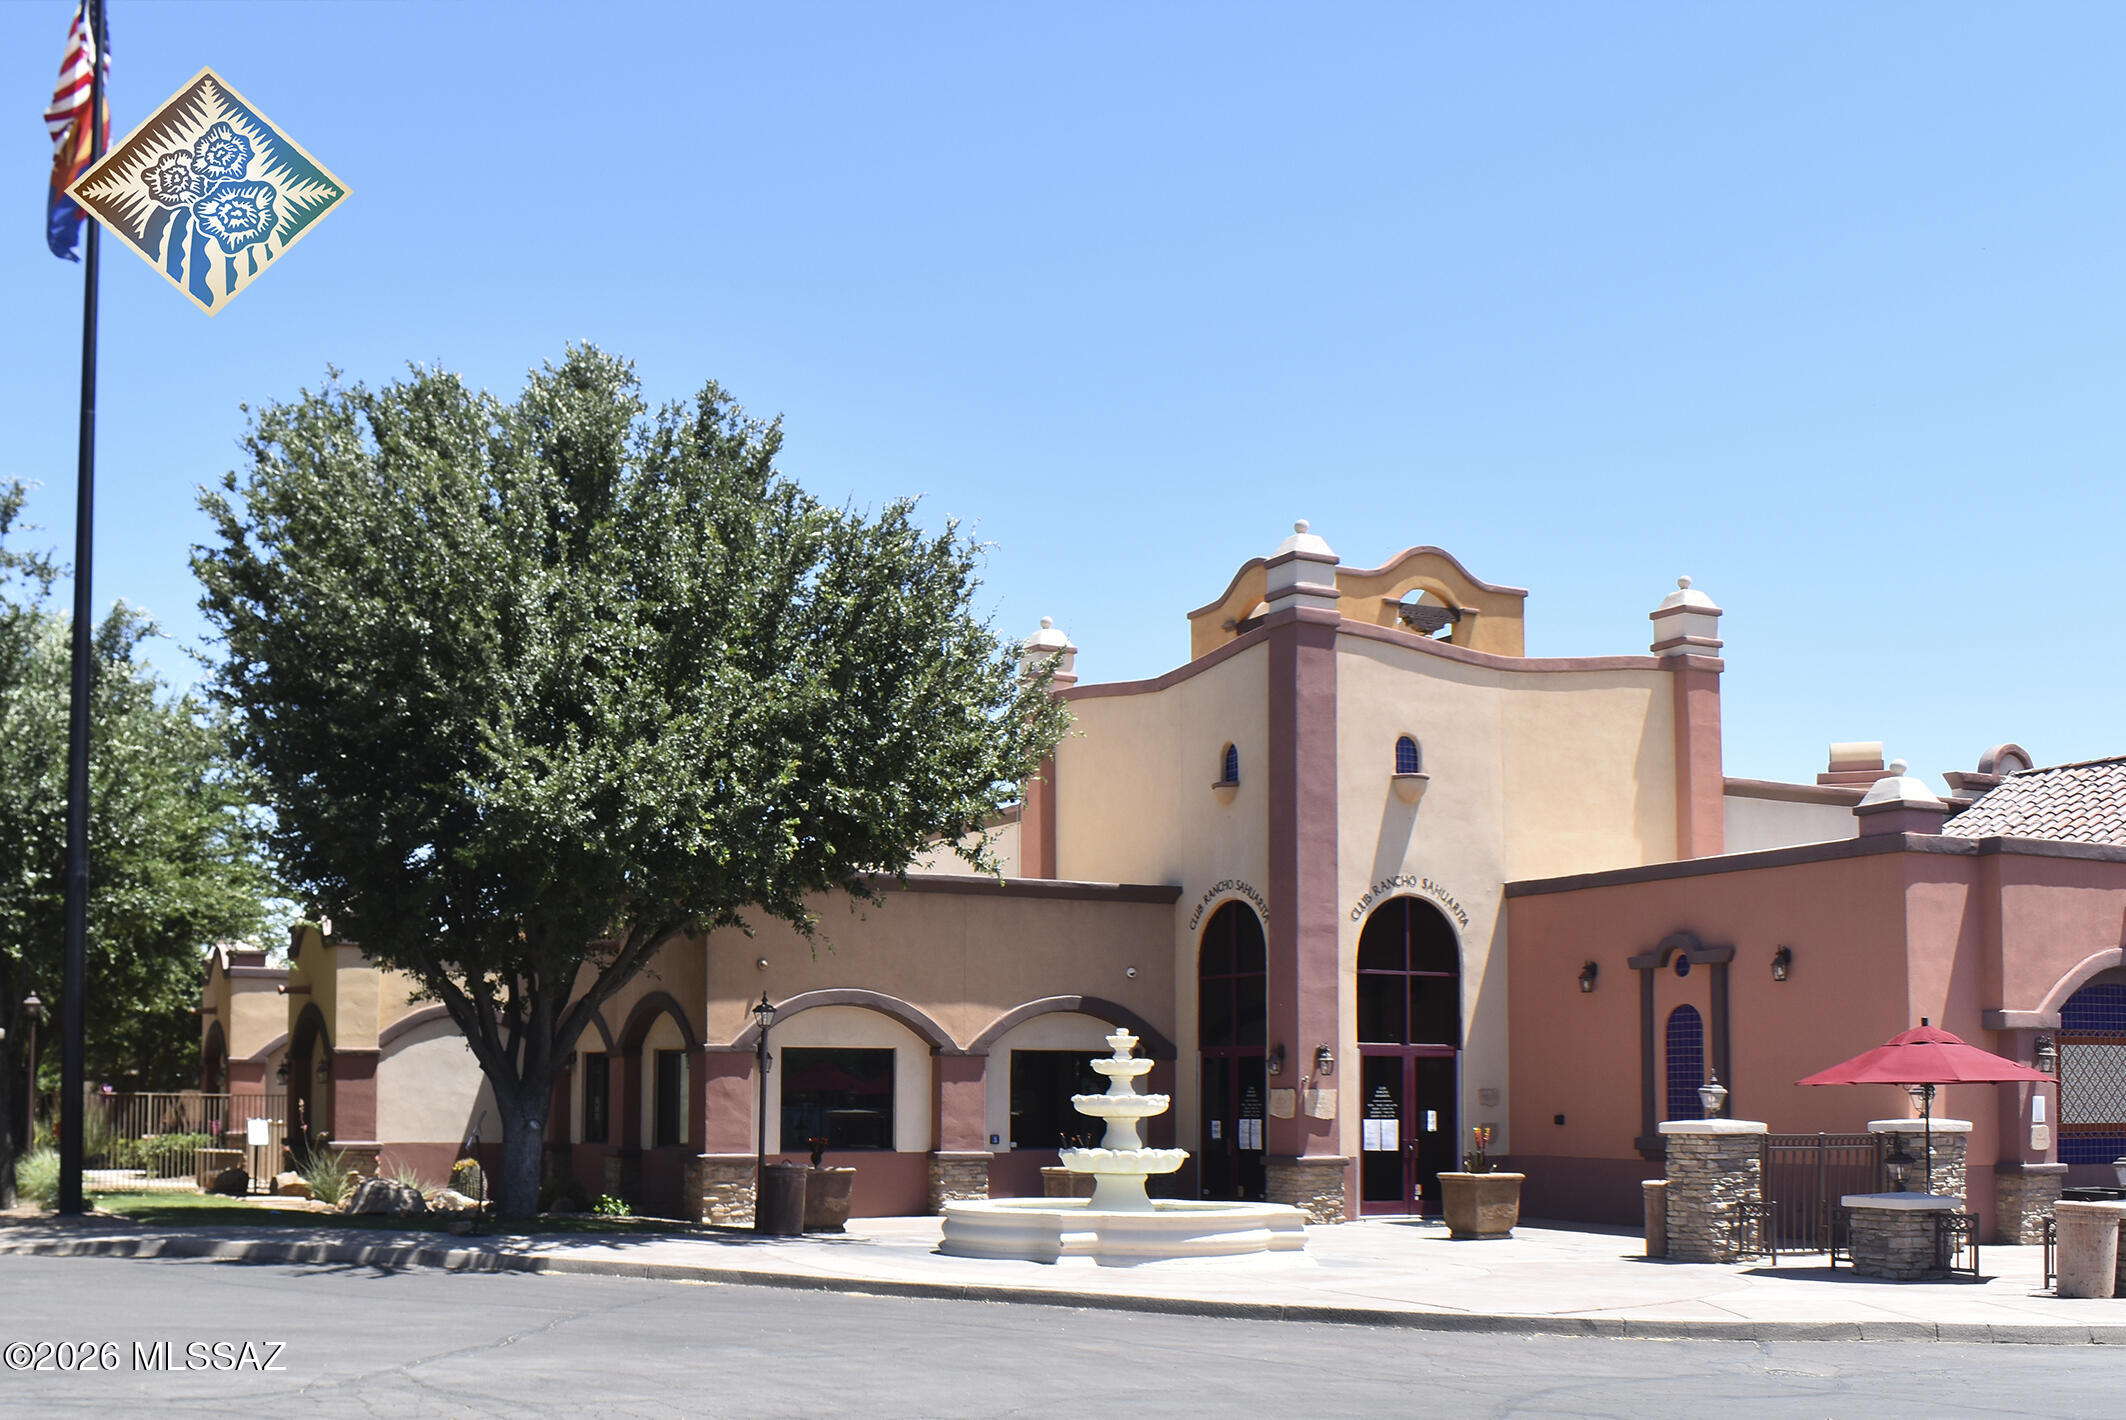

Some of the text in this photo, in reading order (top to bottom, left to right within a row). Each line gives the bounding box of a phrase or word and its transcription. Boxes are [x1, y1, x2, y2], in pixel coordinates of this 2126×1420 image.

[1189, 879, 1270, 930] CLUB RANCHO SAHUARITA
[1350, 875, 1469, 930] CLUB RANCHO SAHUARITA
